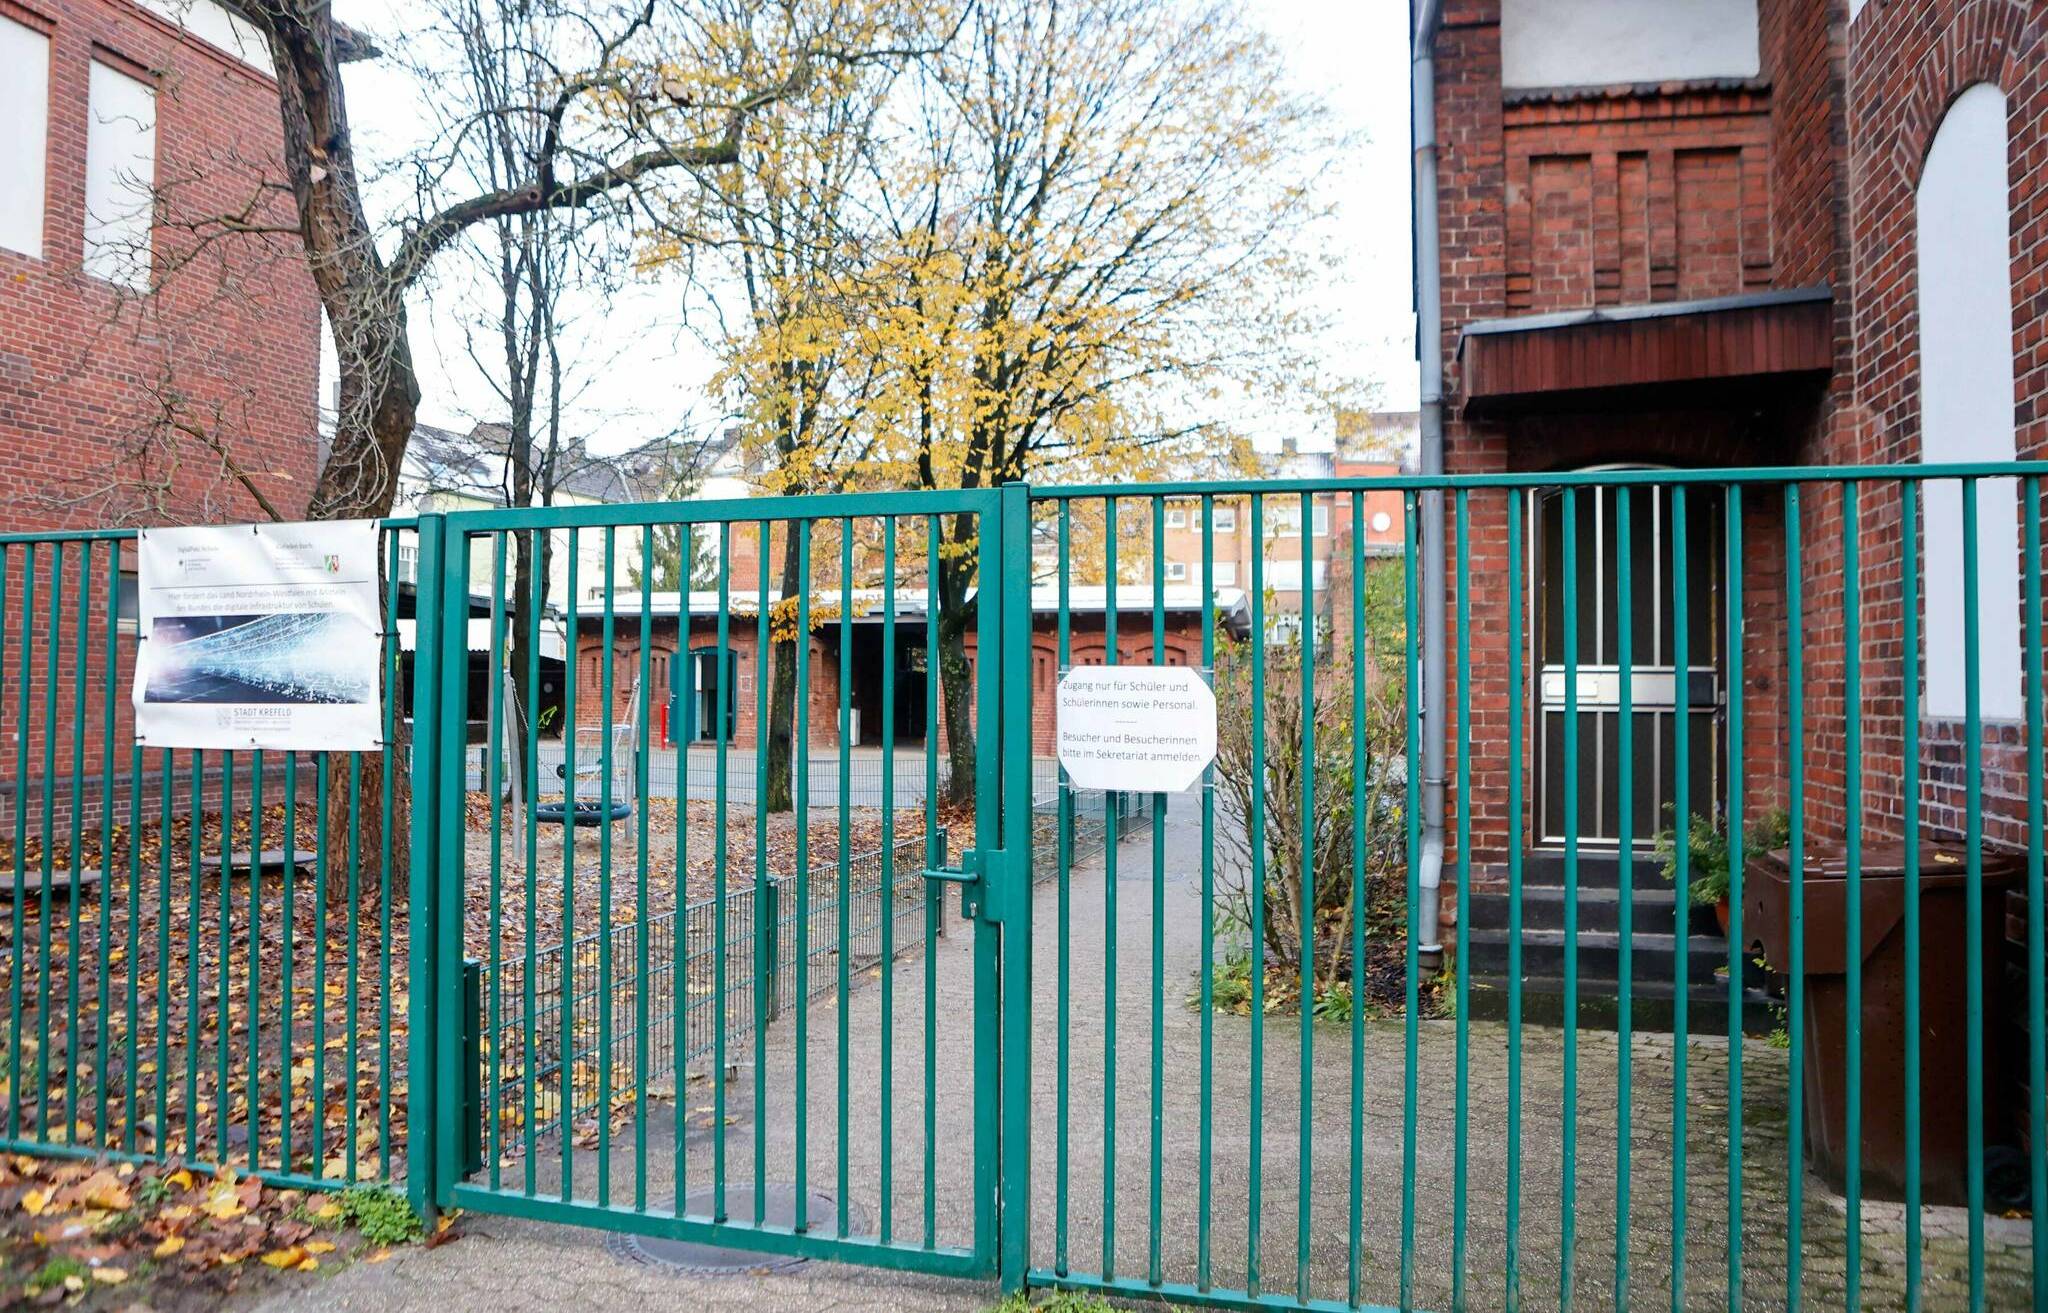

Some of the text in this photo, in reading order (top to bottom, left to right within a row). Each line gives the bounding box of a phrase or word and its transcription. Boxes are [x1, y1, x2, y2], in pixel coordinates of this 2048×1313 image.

[1063, 680, 1189, 692] Zugang nur für Schüler und
[1063, 698, 1119, 708] Schülerinnen
[1121, 700, 1150, 709] sowie
[233, 707, 292, 717] STADT KREFELD
[1063, 732, 1198, 745] Besucher und Besucherinnen
[1062, 748, 1081, 758] bitte
[1083, 750, 1094, 759] im
[1096, 750, 1148, 760] Sekretariat
